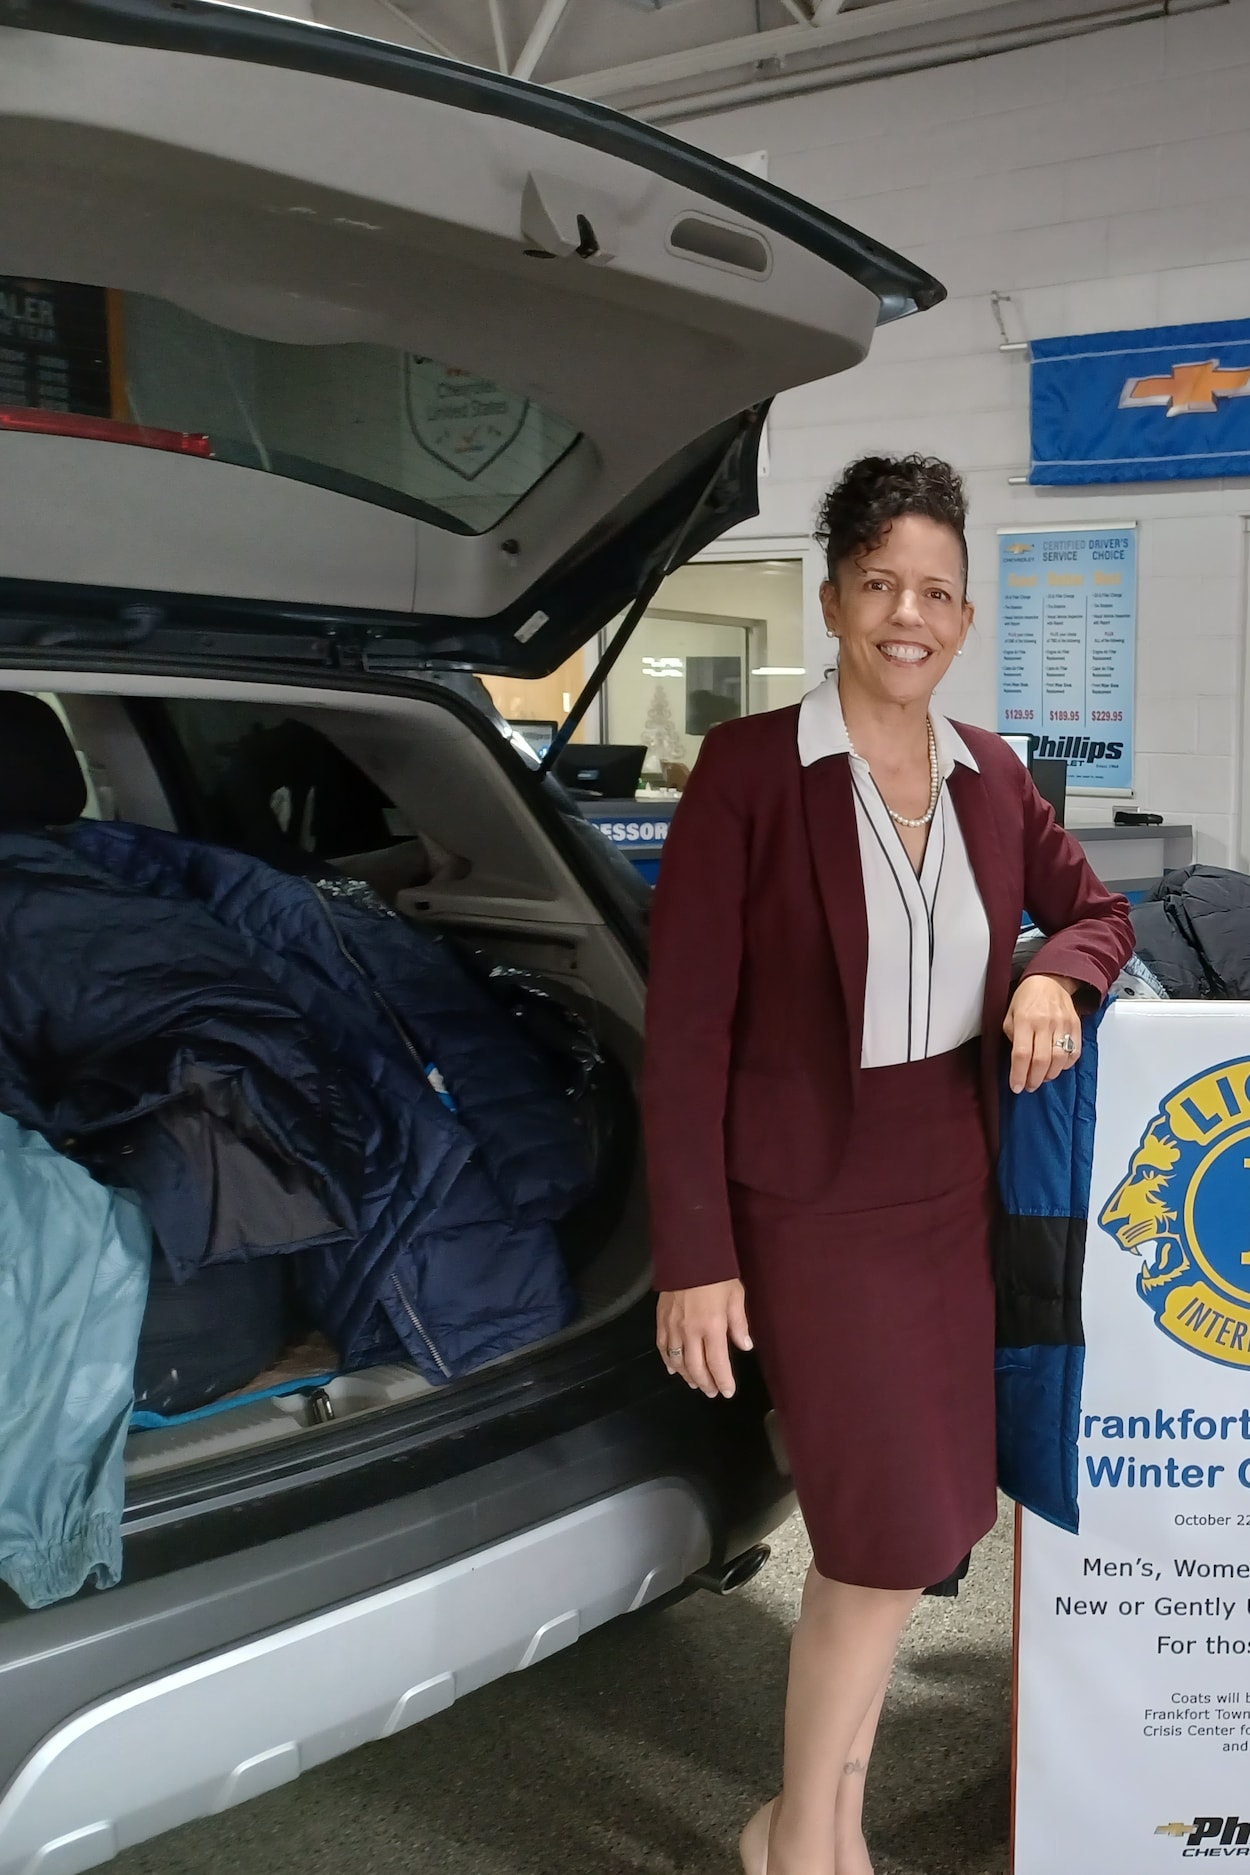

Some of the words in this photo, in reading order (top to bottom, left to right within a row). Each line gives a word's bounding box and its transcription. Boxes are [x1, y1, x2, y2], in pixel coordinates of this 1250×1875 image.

[1042, 539, 1086, 551] CERTIFIED
[1088, 538, 1129, 550] DRIVER'S
[1042, 551, 1078, 562] SERVICE
[1092, 550, 1125, 561] CHOICE
[1005, 709, 1034, 720] $129.95
[1049, 710, 1080, 721] $189.95
[1091, 711, 1123, 722] $229.95
[594, 822, 670, 841] ESSOR
[1085, 1456, 1225, 1488] Winter
[1174, 1513, 1231, 1526] October
[1083, 1557, 1162, 1580] Men's,
[1055, 1597, 1107, 1615] New
[1118, 1601, 1145, 1616] or
[1154, 1597, 1236, 1620] Gently
[1157, 1636, 1197, 1655] For
[1171, 1692, 1211, 1704] Coats
[1216, 1692, 1240, 1703] will
[1144, 1708, 1210, 1720] Frankfort
[1143, 1725, 1182, 1737] Crisis
[1187, 1725, 1235, 1736] Center
[1222, 1741, 1248, 1752] and
